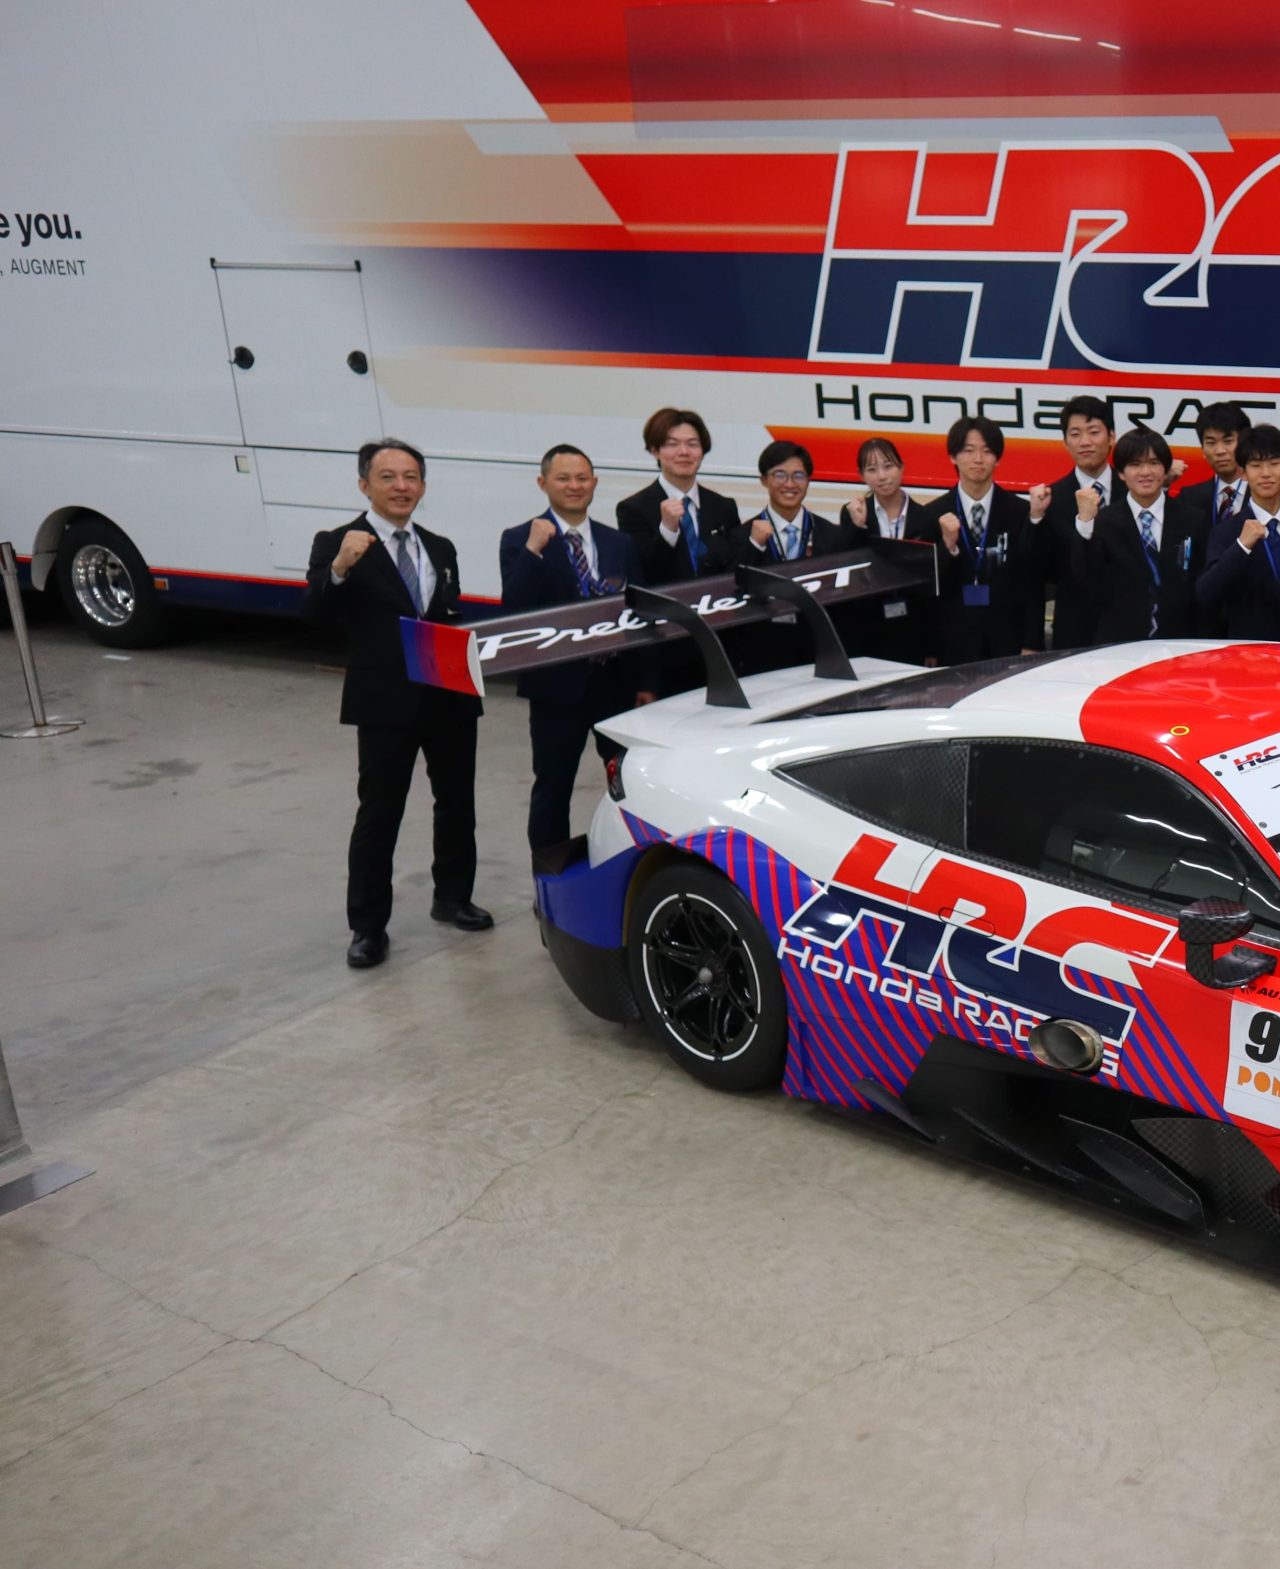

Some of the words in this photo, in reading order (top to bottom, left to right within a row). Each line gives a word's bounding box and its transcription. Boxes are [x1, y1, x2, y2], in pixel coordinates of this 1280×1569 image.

[14, 213, 82, 247] you.
[11, 258, 86, 276] AUGMENT
[815, 383, 1064, 431] Honda
[782, 832, 1179, 1049] HRC
[776, 937, 943, 1013] Honda
[953, 996, 1120, 1078] RACG
